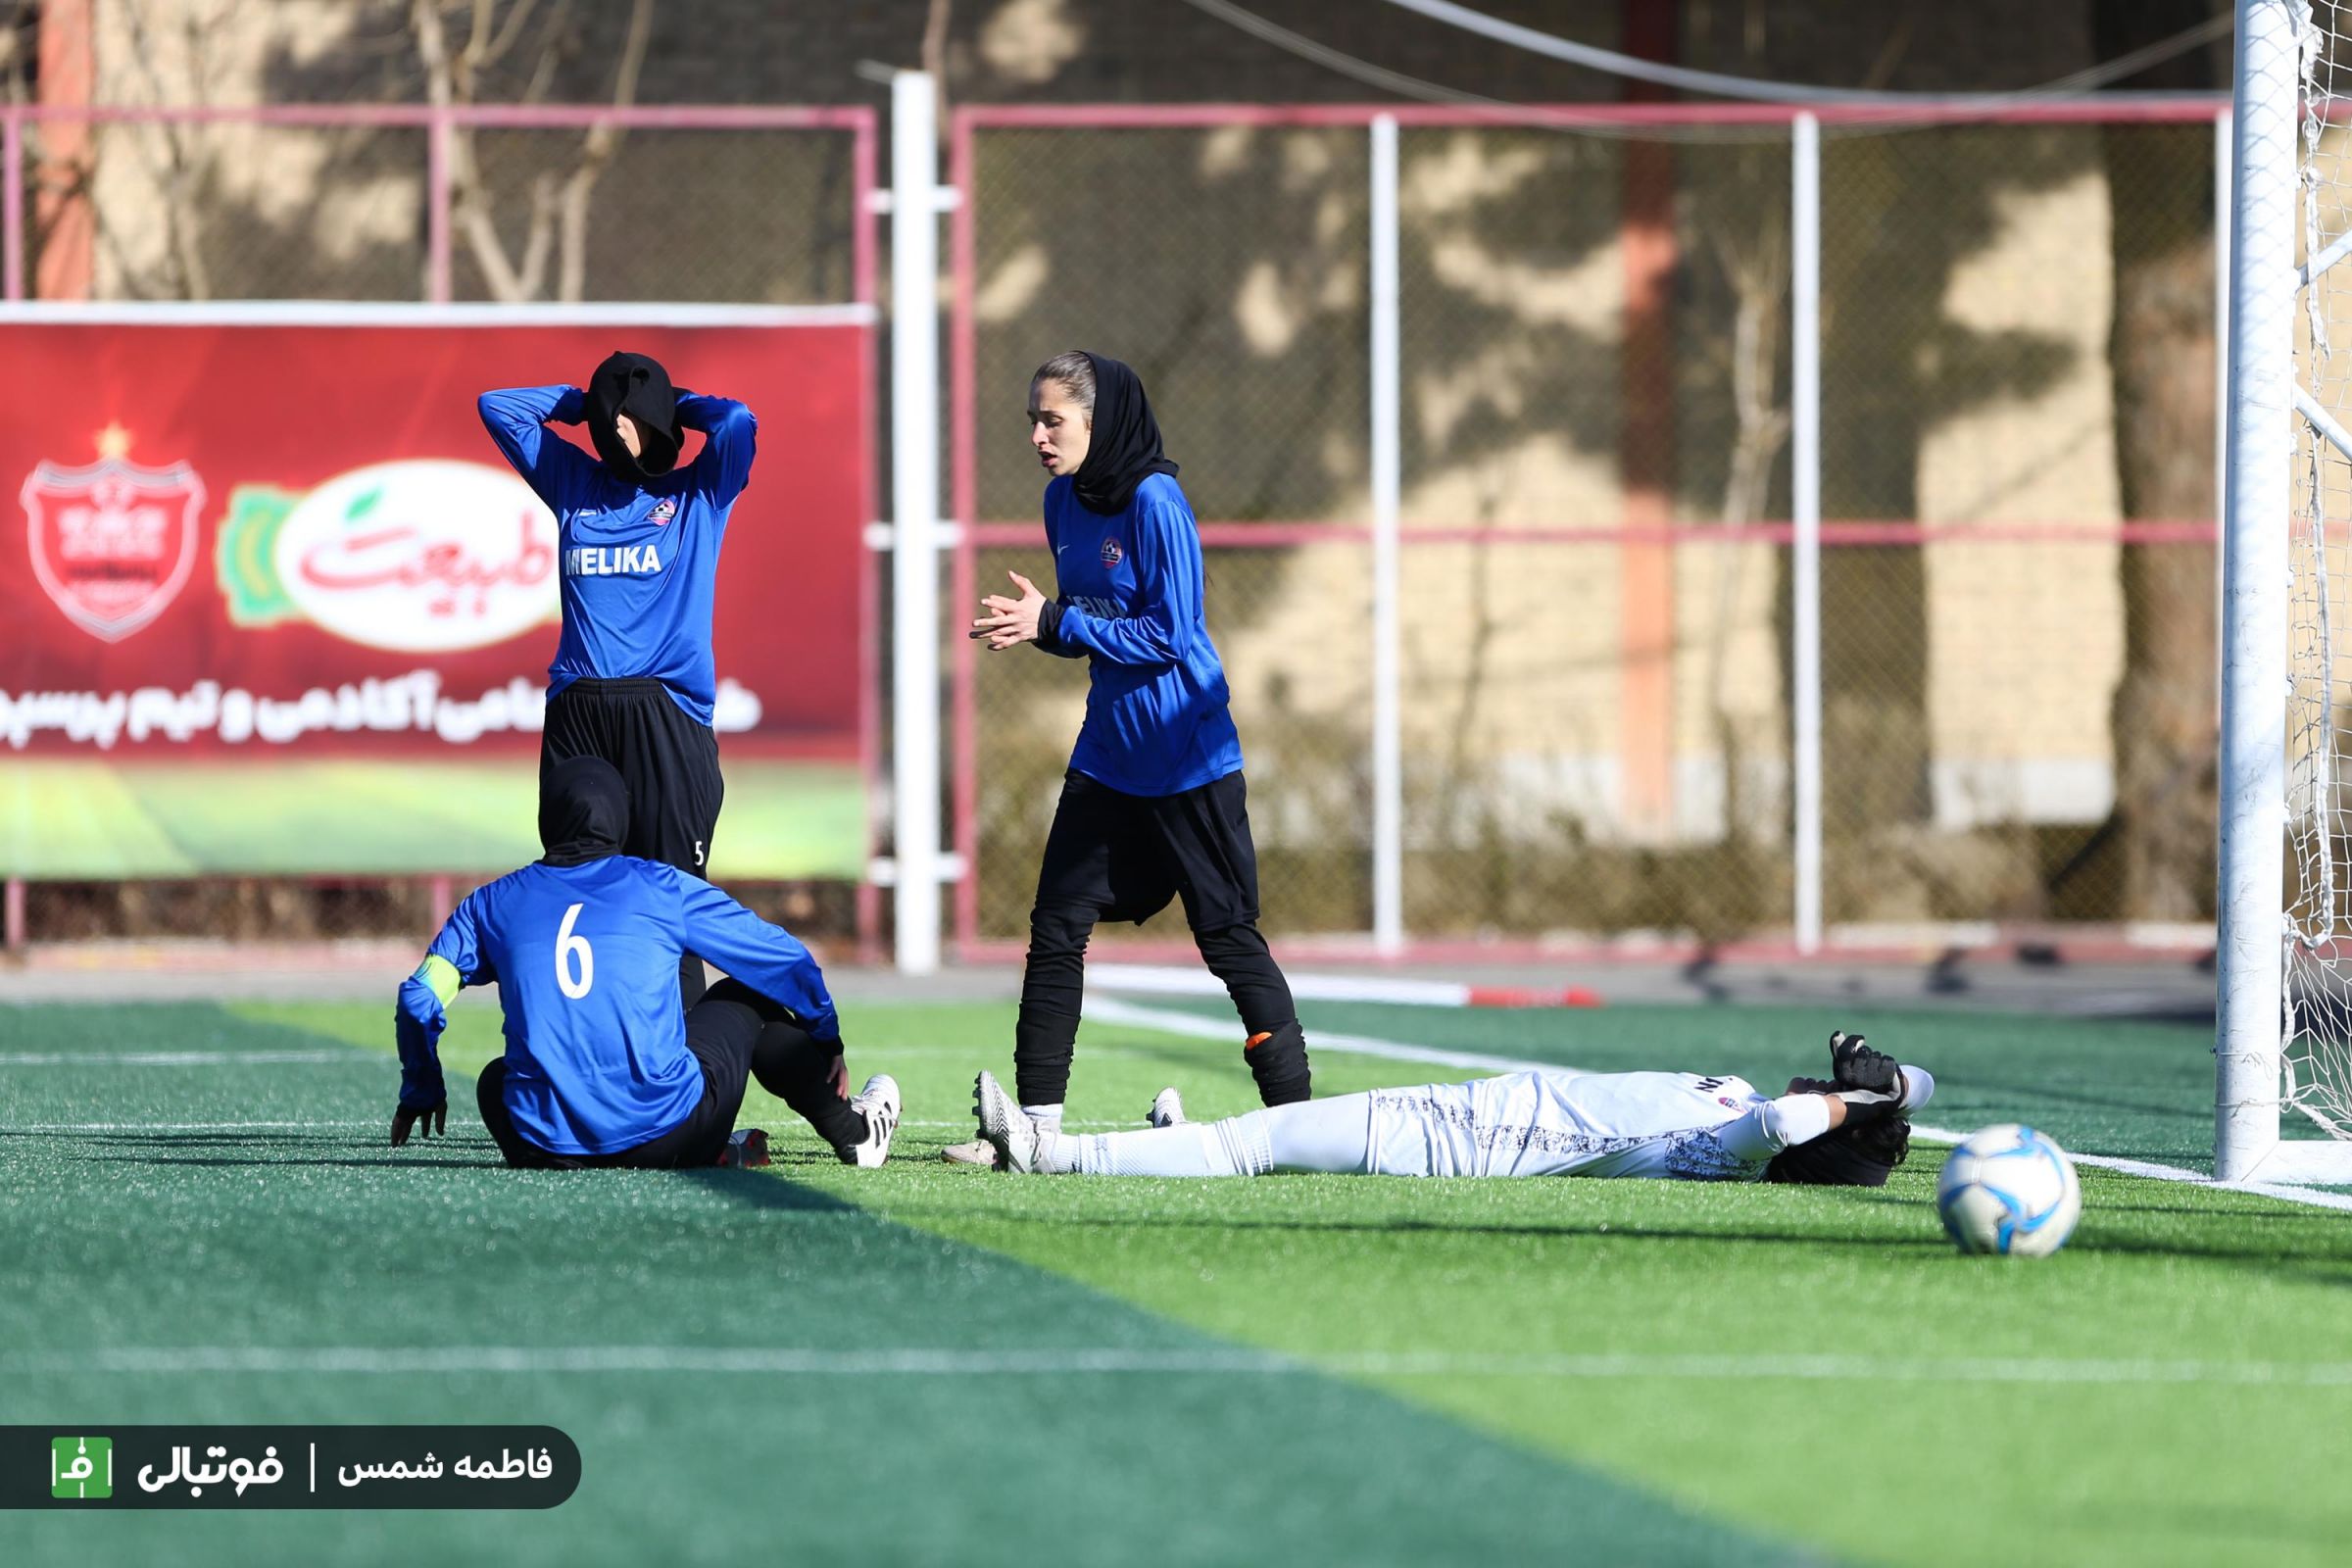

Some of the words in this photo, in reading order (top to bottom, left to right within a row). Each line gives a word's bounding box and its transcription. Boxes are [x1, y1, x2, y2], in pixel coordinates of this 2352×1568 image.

[565, 545, 662, 576] MELIKA
[694, 841, 705, 866] 5
[555, 903, 595, 1000] 6
